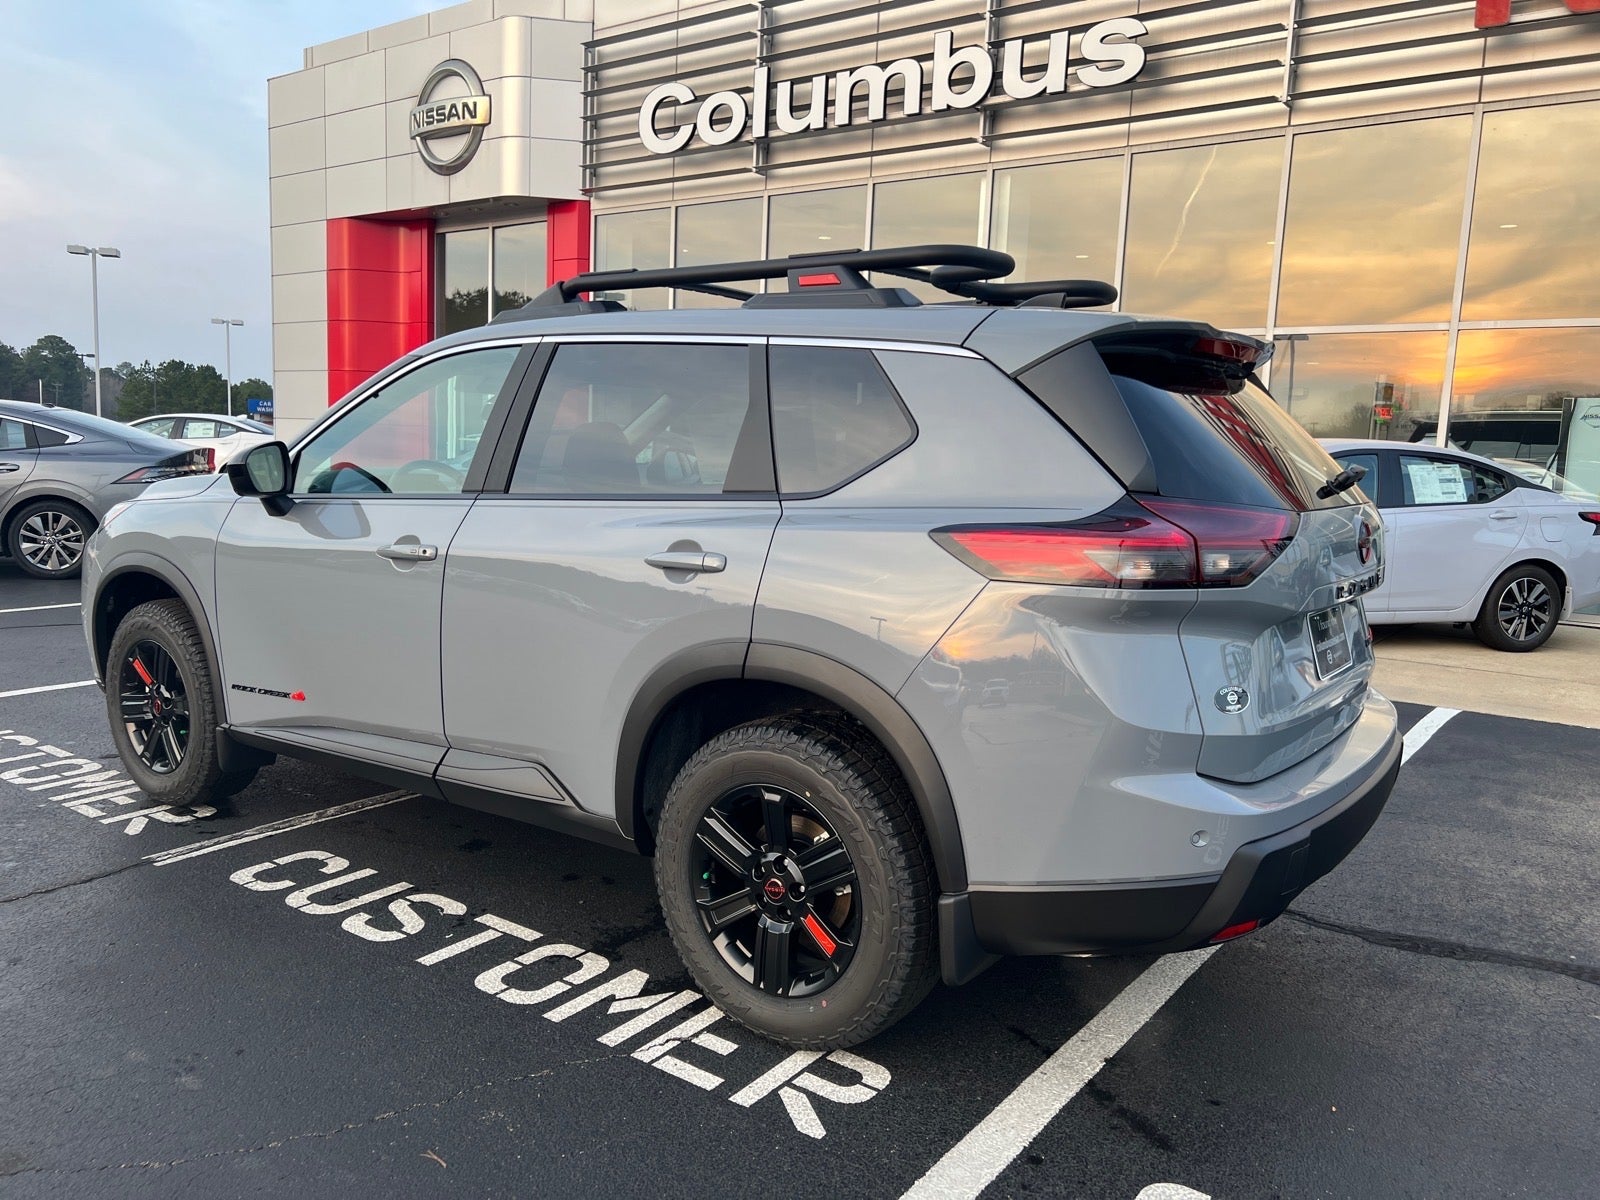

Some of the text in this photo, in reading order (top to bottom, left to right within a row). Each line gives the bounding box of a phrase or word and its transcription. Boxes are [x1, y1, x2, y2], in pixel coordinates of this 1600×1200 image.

[411, 101, 477, 132] NISSAN
[638, 17, 1148, 155] Columbus
[229, 850, 892, 1139] CUSTOMER
